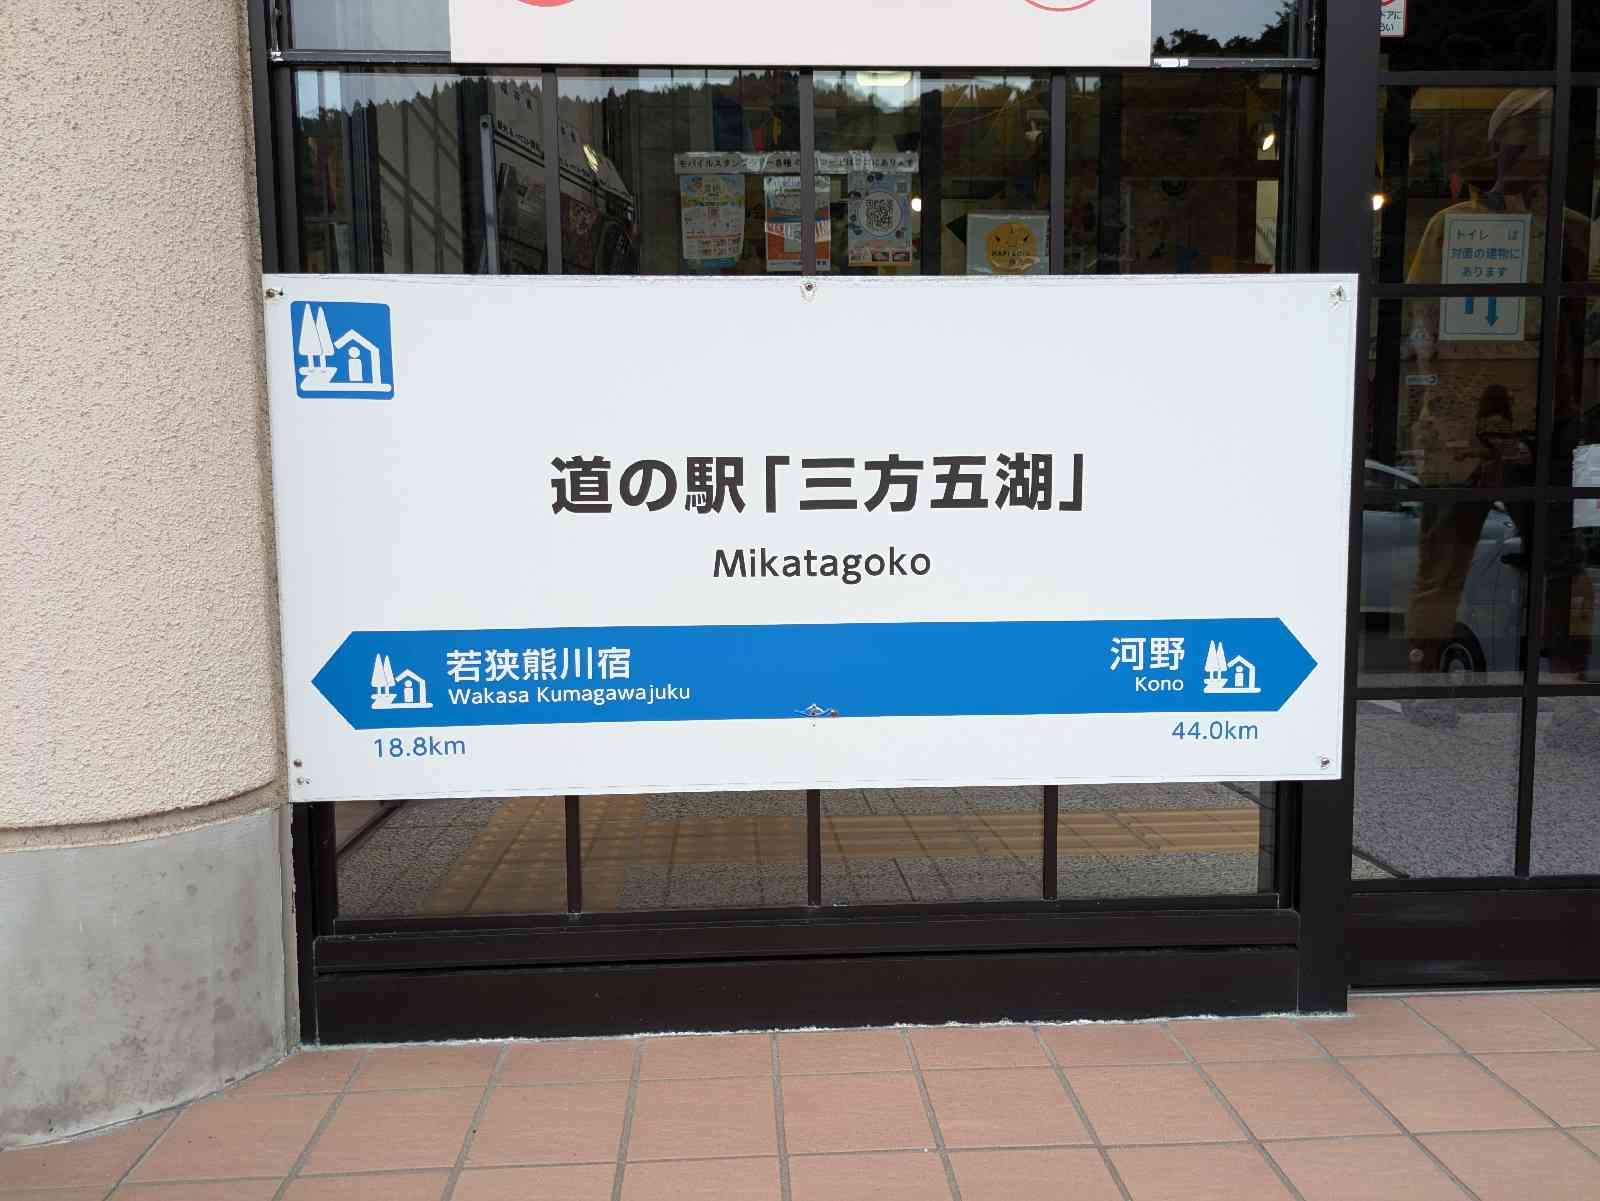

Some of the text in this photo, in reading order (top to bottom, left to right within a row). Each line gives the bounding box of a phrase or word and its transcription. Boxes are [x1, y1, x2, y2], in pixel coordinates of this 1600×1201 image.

[551, 453, 1084, 515] 道の駅「三方五湖」
[714, 546, 931, 585] Mikatagoko
[446, 646, 631, 683] 若狭熊川宿
[1110, 637, 1185, 671] 河野
[448, 683, 691, 706] Wakasa Kumagawajuku
[1135, 676, 1184, 692] Kono
[1171, 720, 1258, 740] 44.0km
[373, 735, 466, 758] 18.8km
